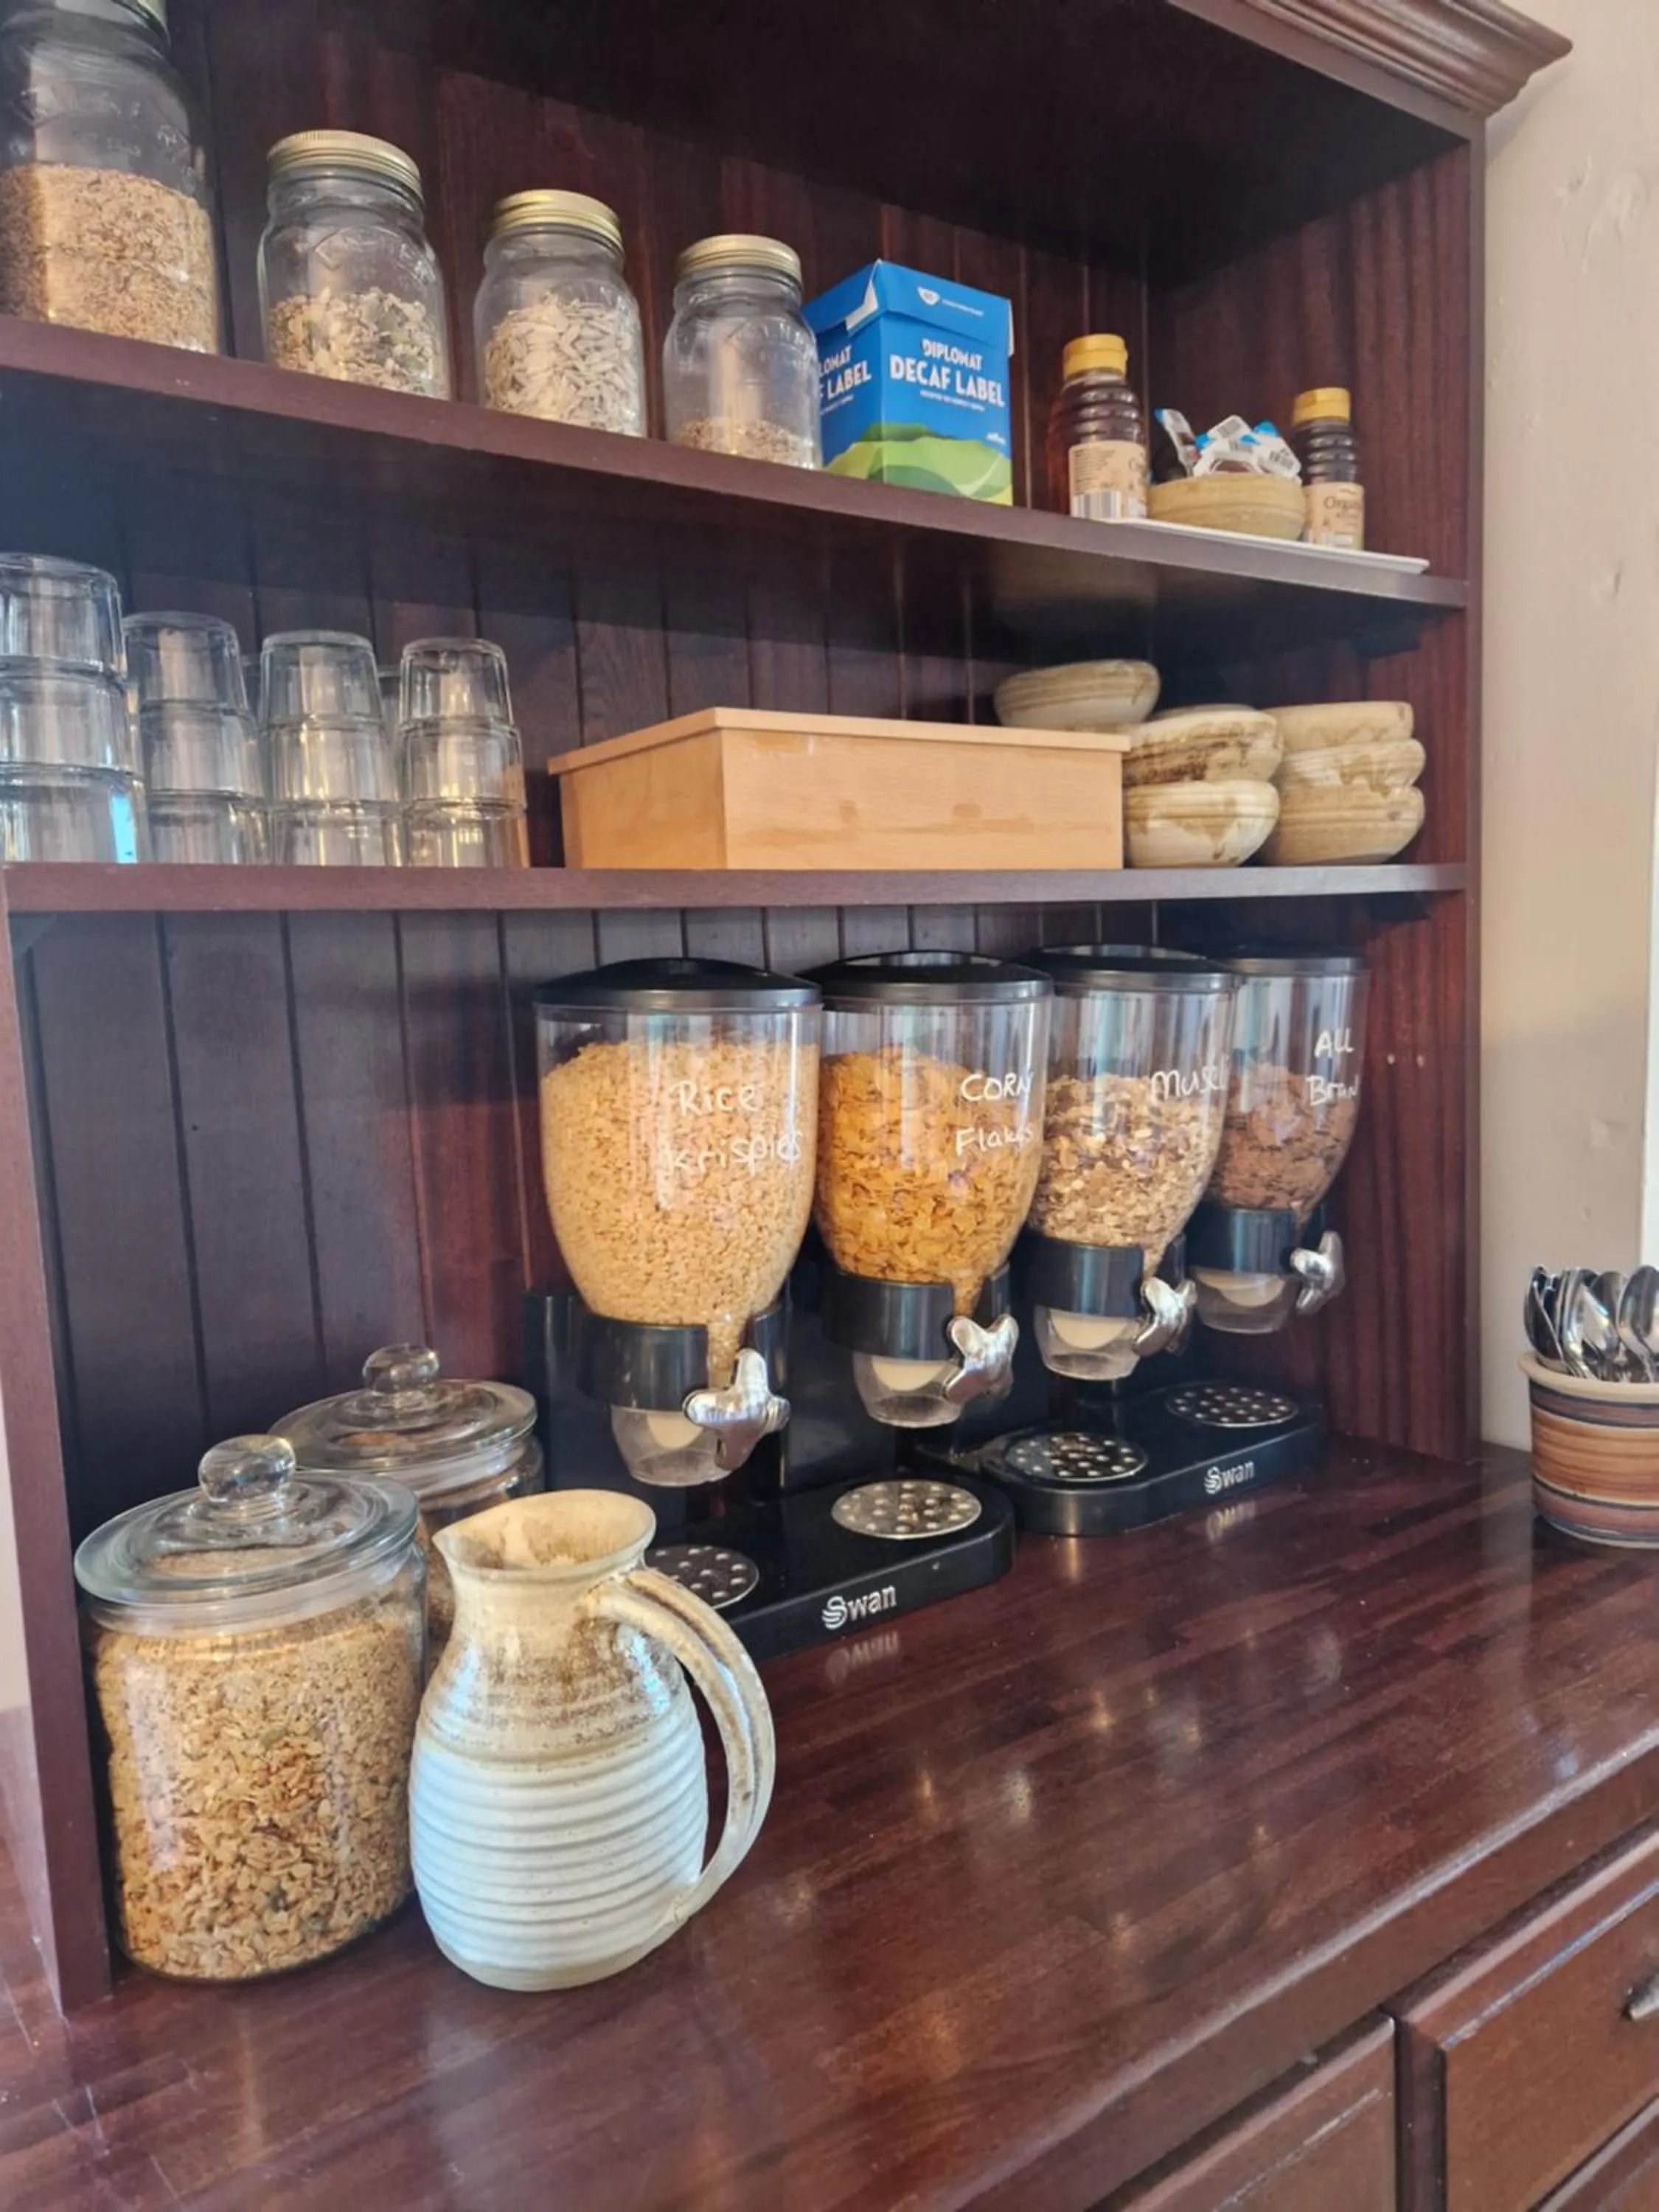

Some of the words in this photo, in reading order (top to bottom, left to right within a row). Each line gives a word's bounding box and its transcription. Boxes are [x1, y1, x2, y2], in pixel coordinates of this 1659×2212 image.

[922, 338, 983, 371] DIPLOMAT
[827, 360, 872, 400] LABEL
[889, 353, 951, 390] DECAF
[955, 369, 1006, 408] LABEL
[669, 1079, 760, 1117] Rice
[961, 1071, 1035, 1101] CORN
[1203, 1461, 1255, 1495] Swan
[821, 1585, 897, 1630] Swan
